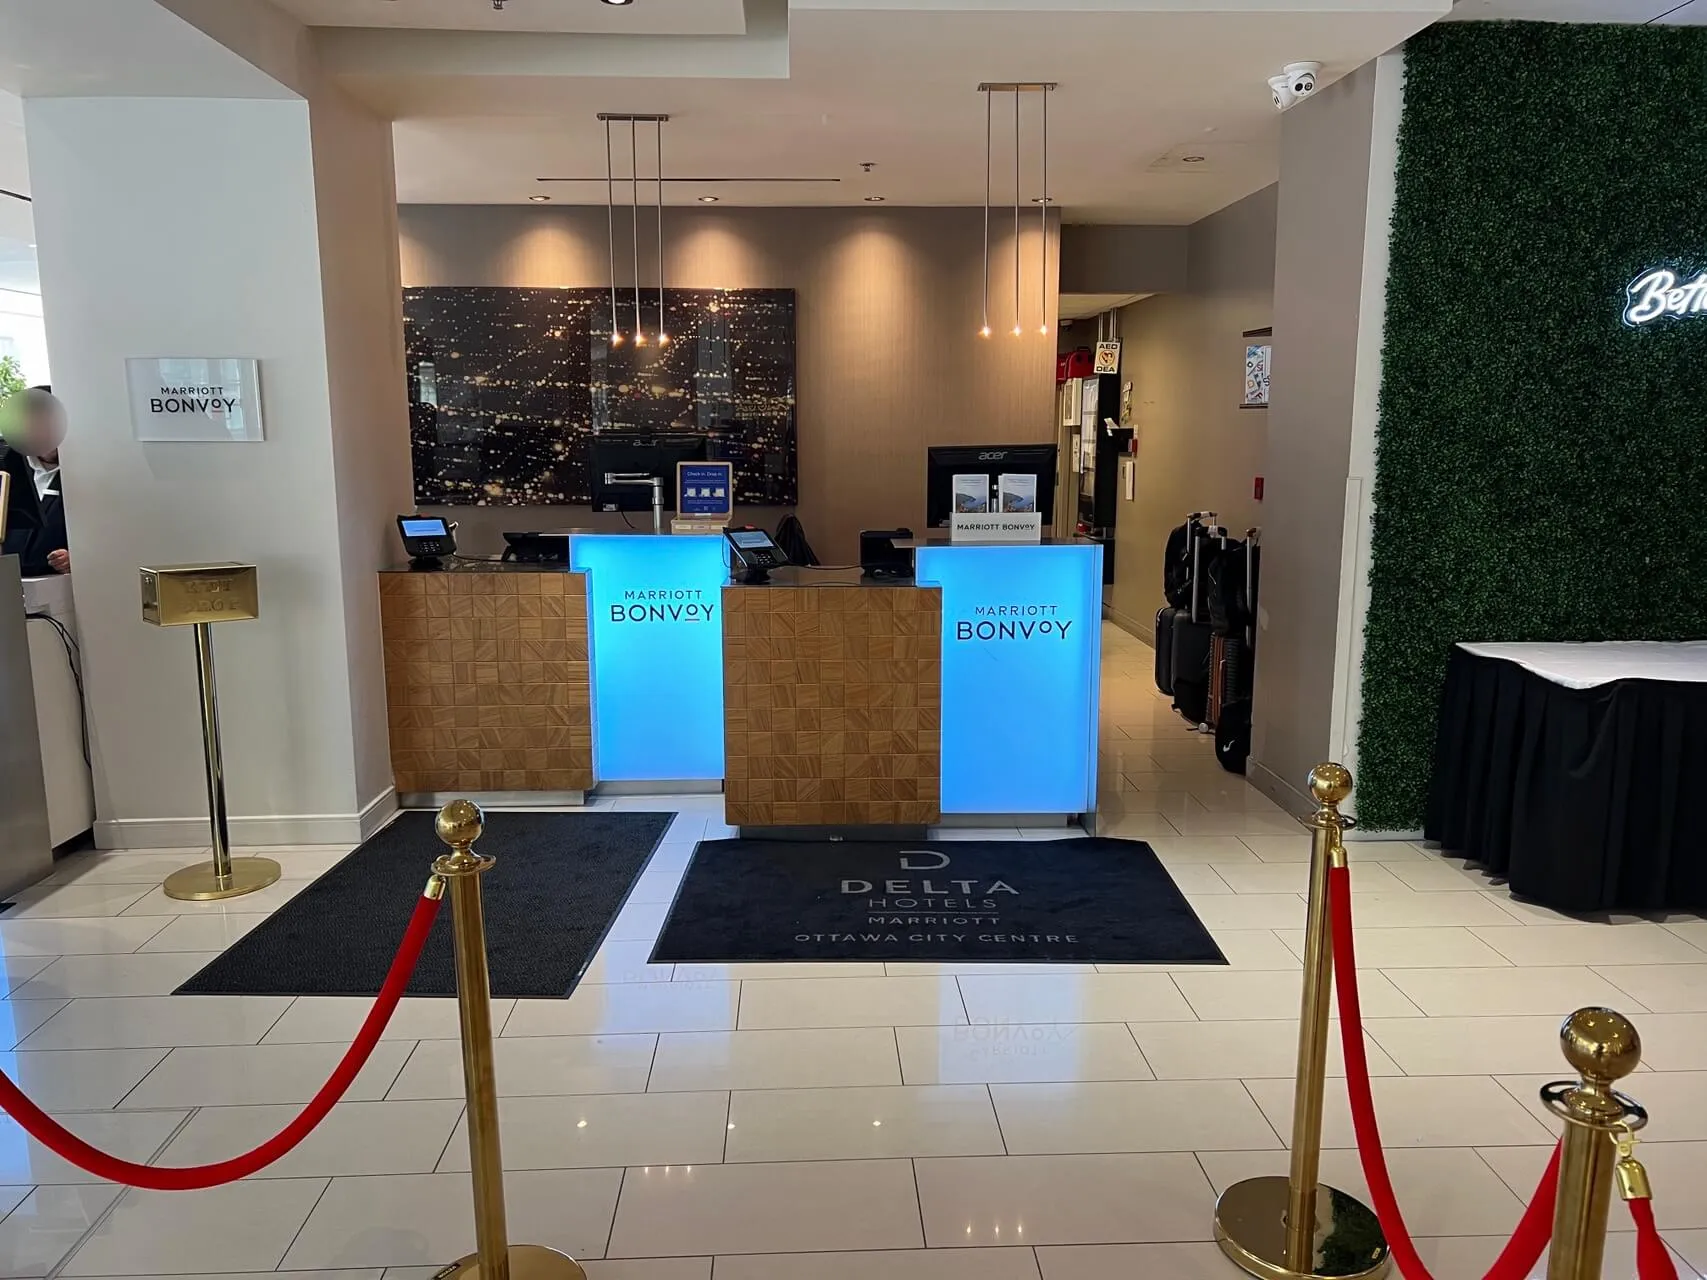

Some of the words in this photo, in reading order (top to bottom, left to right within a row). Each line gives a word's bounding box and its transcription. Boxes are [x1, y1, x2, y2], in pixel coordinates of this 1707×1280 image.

[160, 386, 224, 396] MARRIOTT
[978, 451, 1009, 461] acer
[956, 523, 1001, 531] MARRIOTT
[624, 590, 703, 601] MARRIOTT
[975, 605, 1058, 616] MARRIOTT
[840, 879, 1020, 895] DELTA
[867, 897, 998, 909] HOTELS
[867, 916, 1001, 926] MARRIOTT
[795, 933, 898, 944] OTTAWA
[911, 933, 966, 944] CITY
[978, 933, 1080, 944] CENTRE
